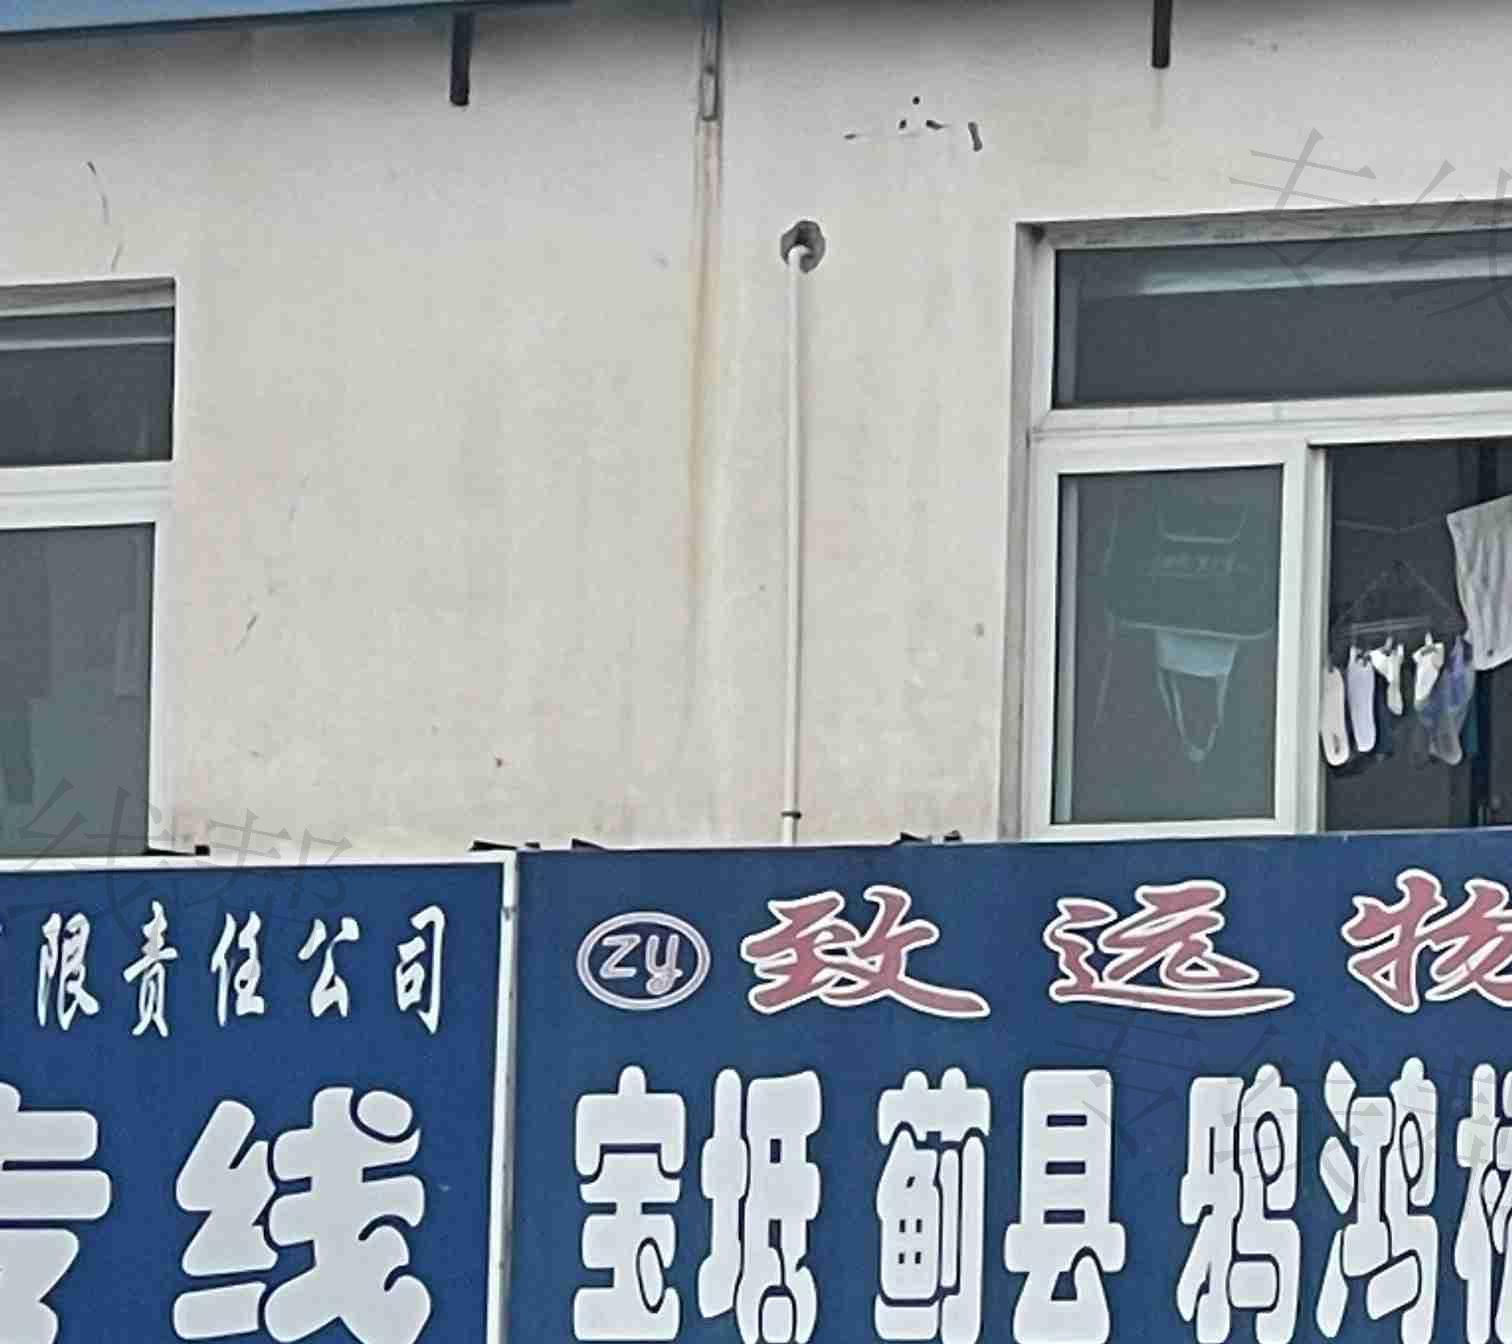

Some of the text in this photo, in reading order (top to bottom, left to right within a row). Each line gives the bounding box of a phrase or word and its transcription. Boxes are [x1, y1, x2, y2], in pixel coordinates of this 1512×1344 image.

[0, 902, 447, 1036] 限责任公司
